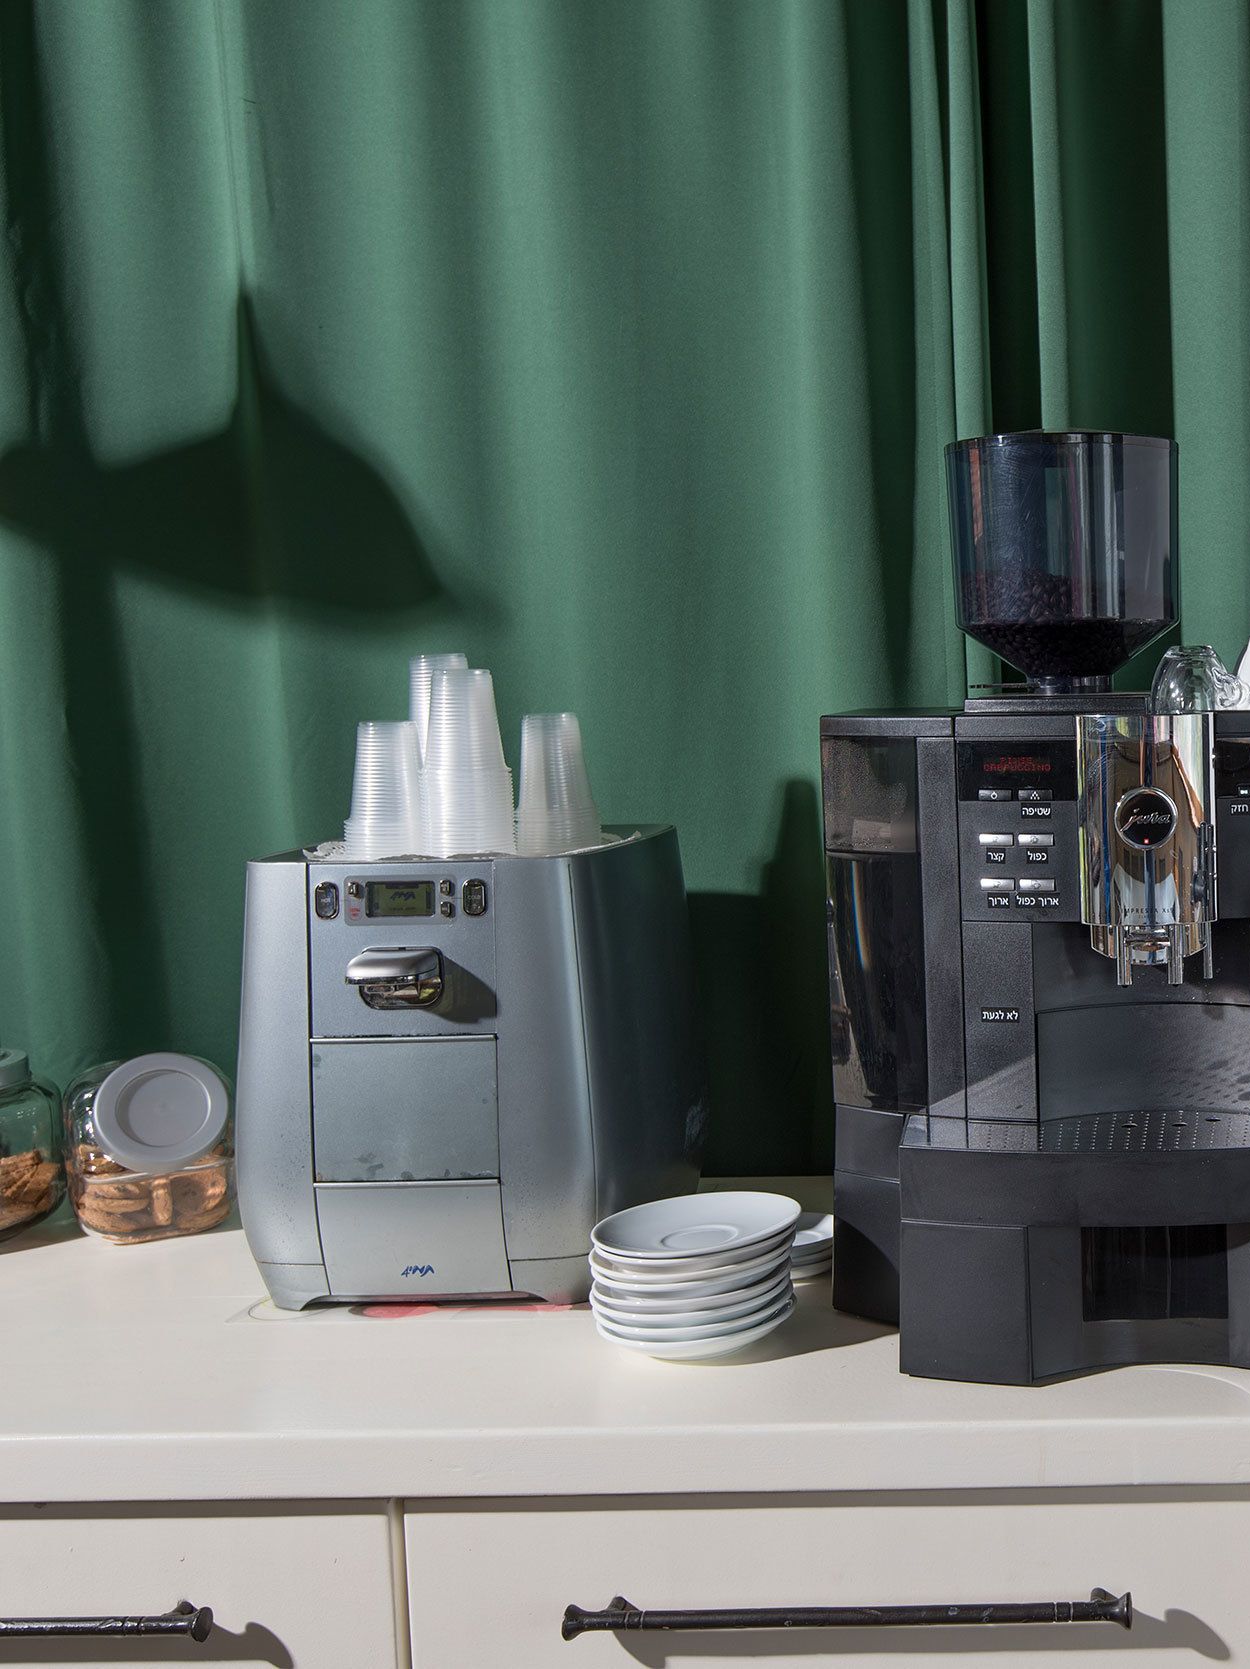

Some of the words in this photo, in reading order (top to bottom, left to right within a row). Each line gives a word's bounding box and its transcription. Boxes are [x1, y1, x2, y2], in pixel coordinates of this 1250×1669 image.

[1022, 807, 1051, 816] שטיפה
[1231, 803, 1249, 814] חזק
[988, 851, 1005, 862] קצר
[1027, 851, 1047, 861] כפול
[988, 896, 1009, 906] ארוך
[1016, 895, 1036, 906] כפול
[1038, 896, 1059, 906] ארוך
[982, 1010, 1006, 1020] לגעת
[1007, 1010, 1018, 1020] לא
